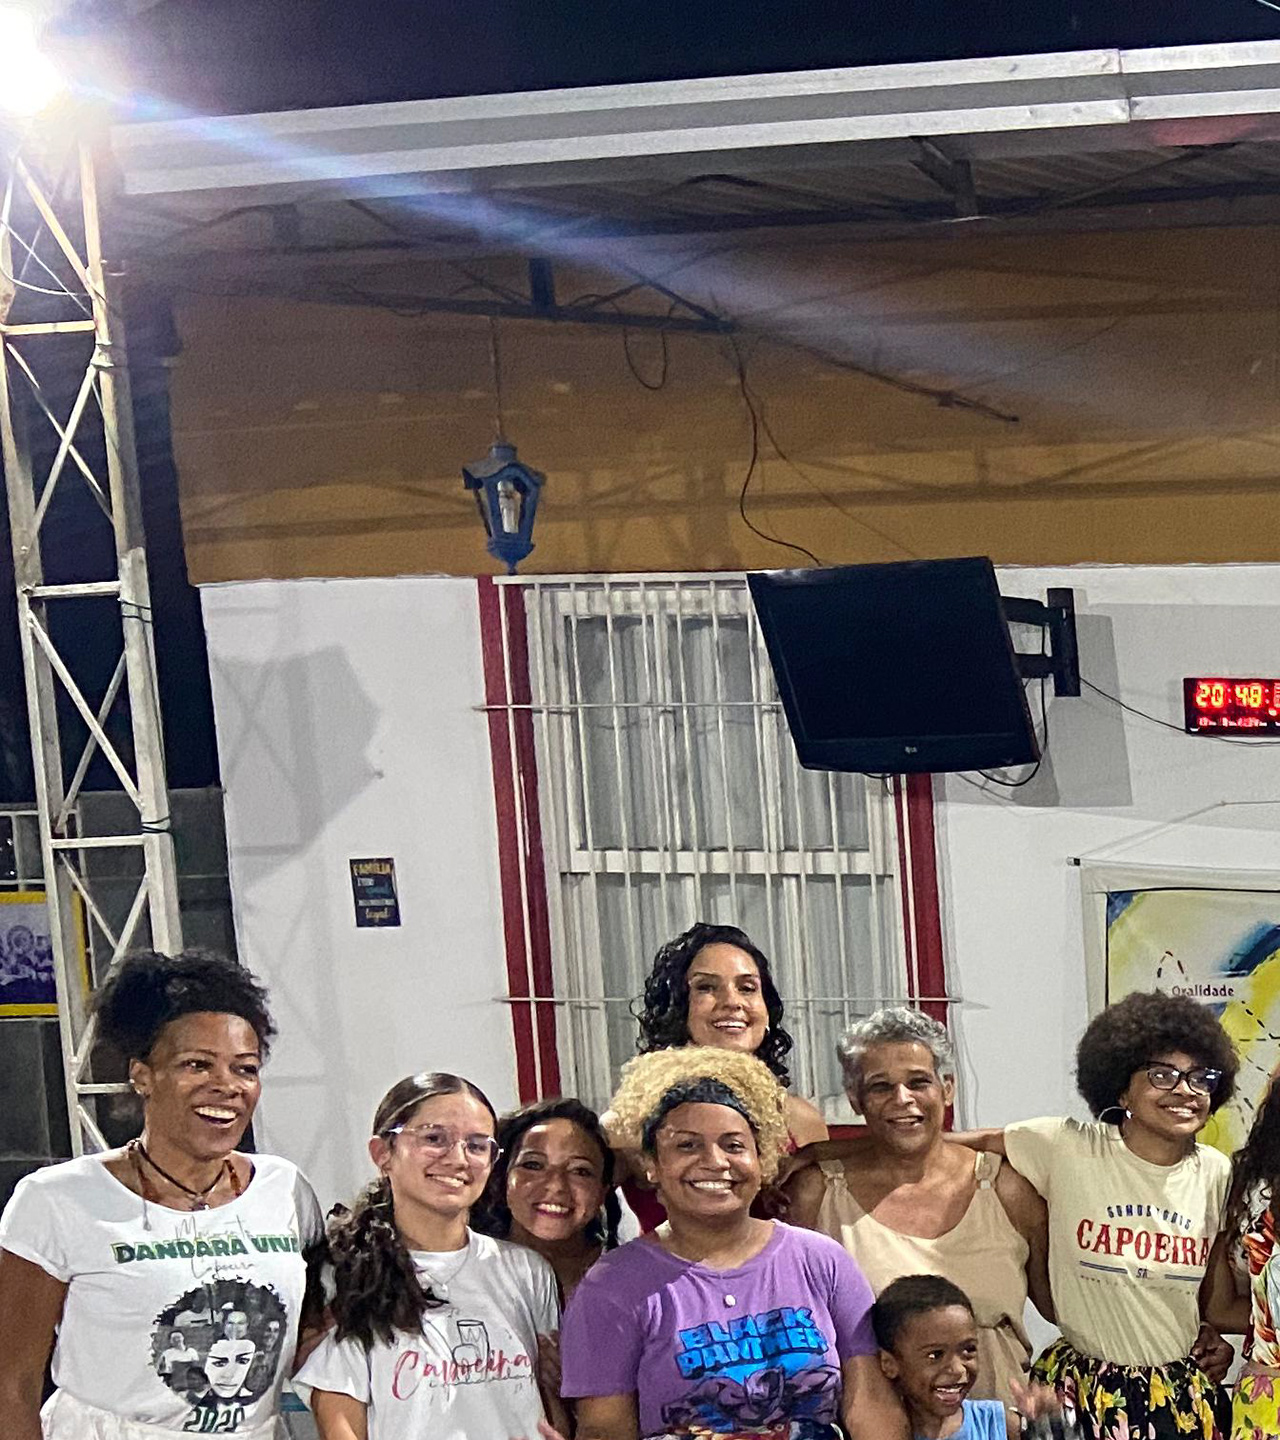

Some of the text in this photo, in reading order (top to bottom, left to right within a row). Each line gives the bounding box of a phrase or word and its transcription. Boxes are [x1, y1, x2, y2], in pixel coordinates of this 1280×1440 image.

[1172, 984, 1234, 997] Oralidade
[111, 1234, 249, 1264] DANDARA
[1076, 1218, 1210, 1267] CAPOEIRA
[679, 1307, 816, 1350] BLACK
[182, 1406, 245, 1433] 2020
